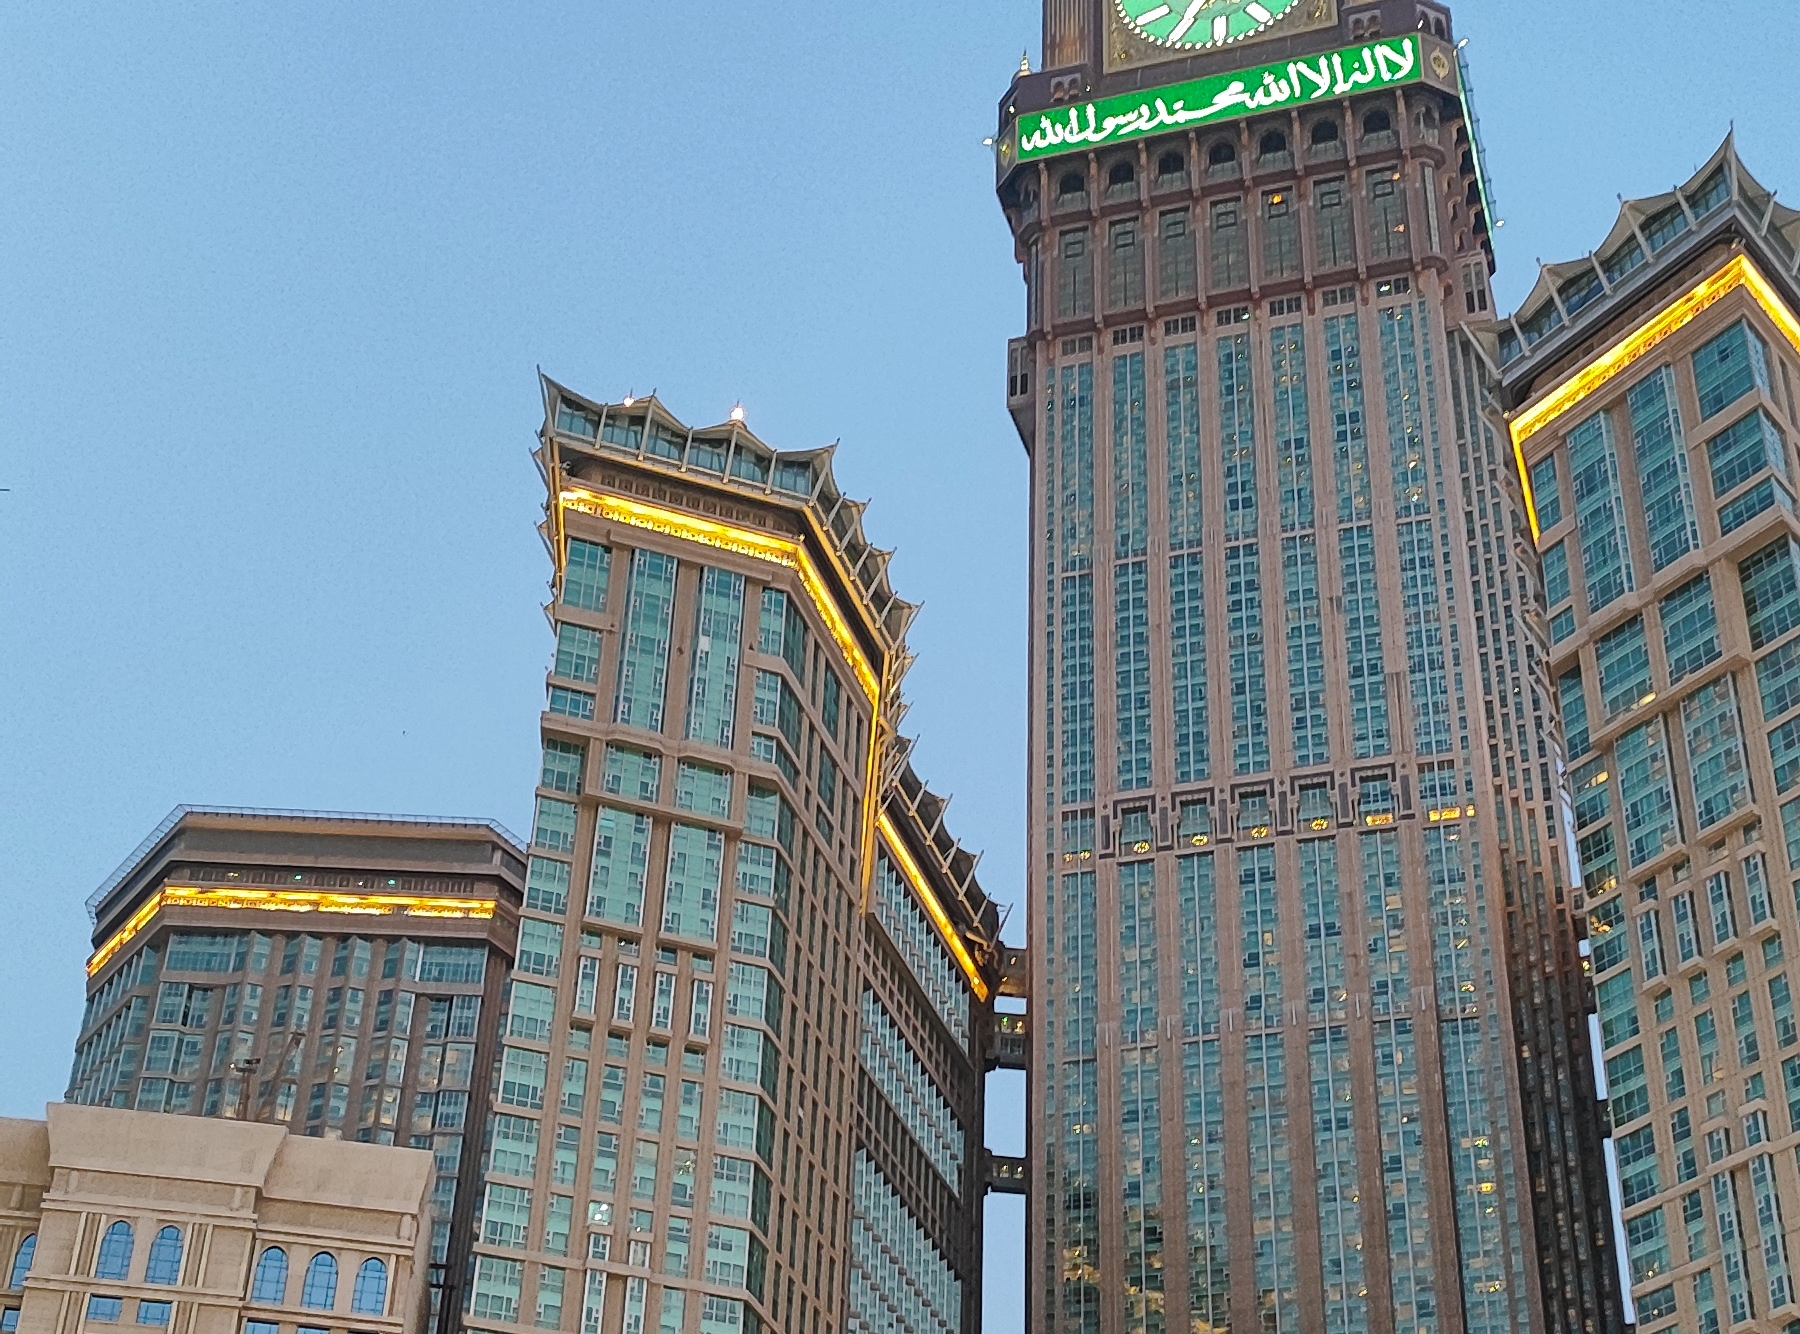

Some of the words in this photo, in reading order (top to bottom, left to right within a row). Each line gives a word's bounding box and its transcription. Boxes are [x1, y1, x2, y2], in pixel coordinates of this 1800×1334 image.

[1139, 80, 1250, 132] محمد
[1246, 61, 1301, 109] الله
[1021, 107, 1079, 151] الله
[1064, 102, 1151, 144] رسول
